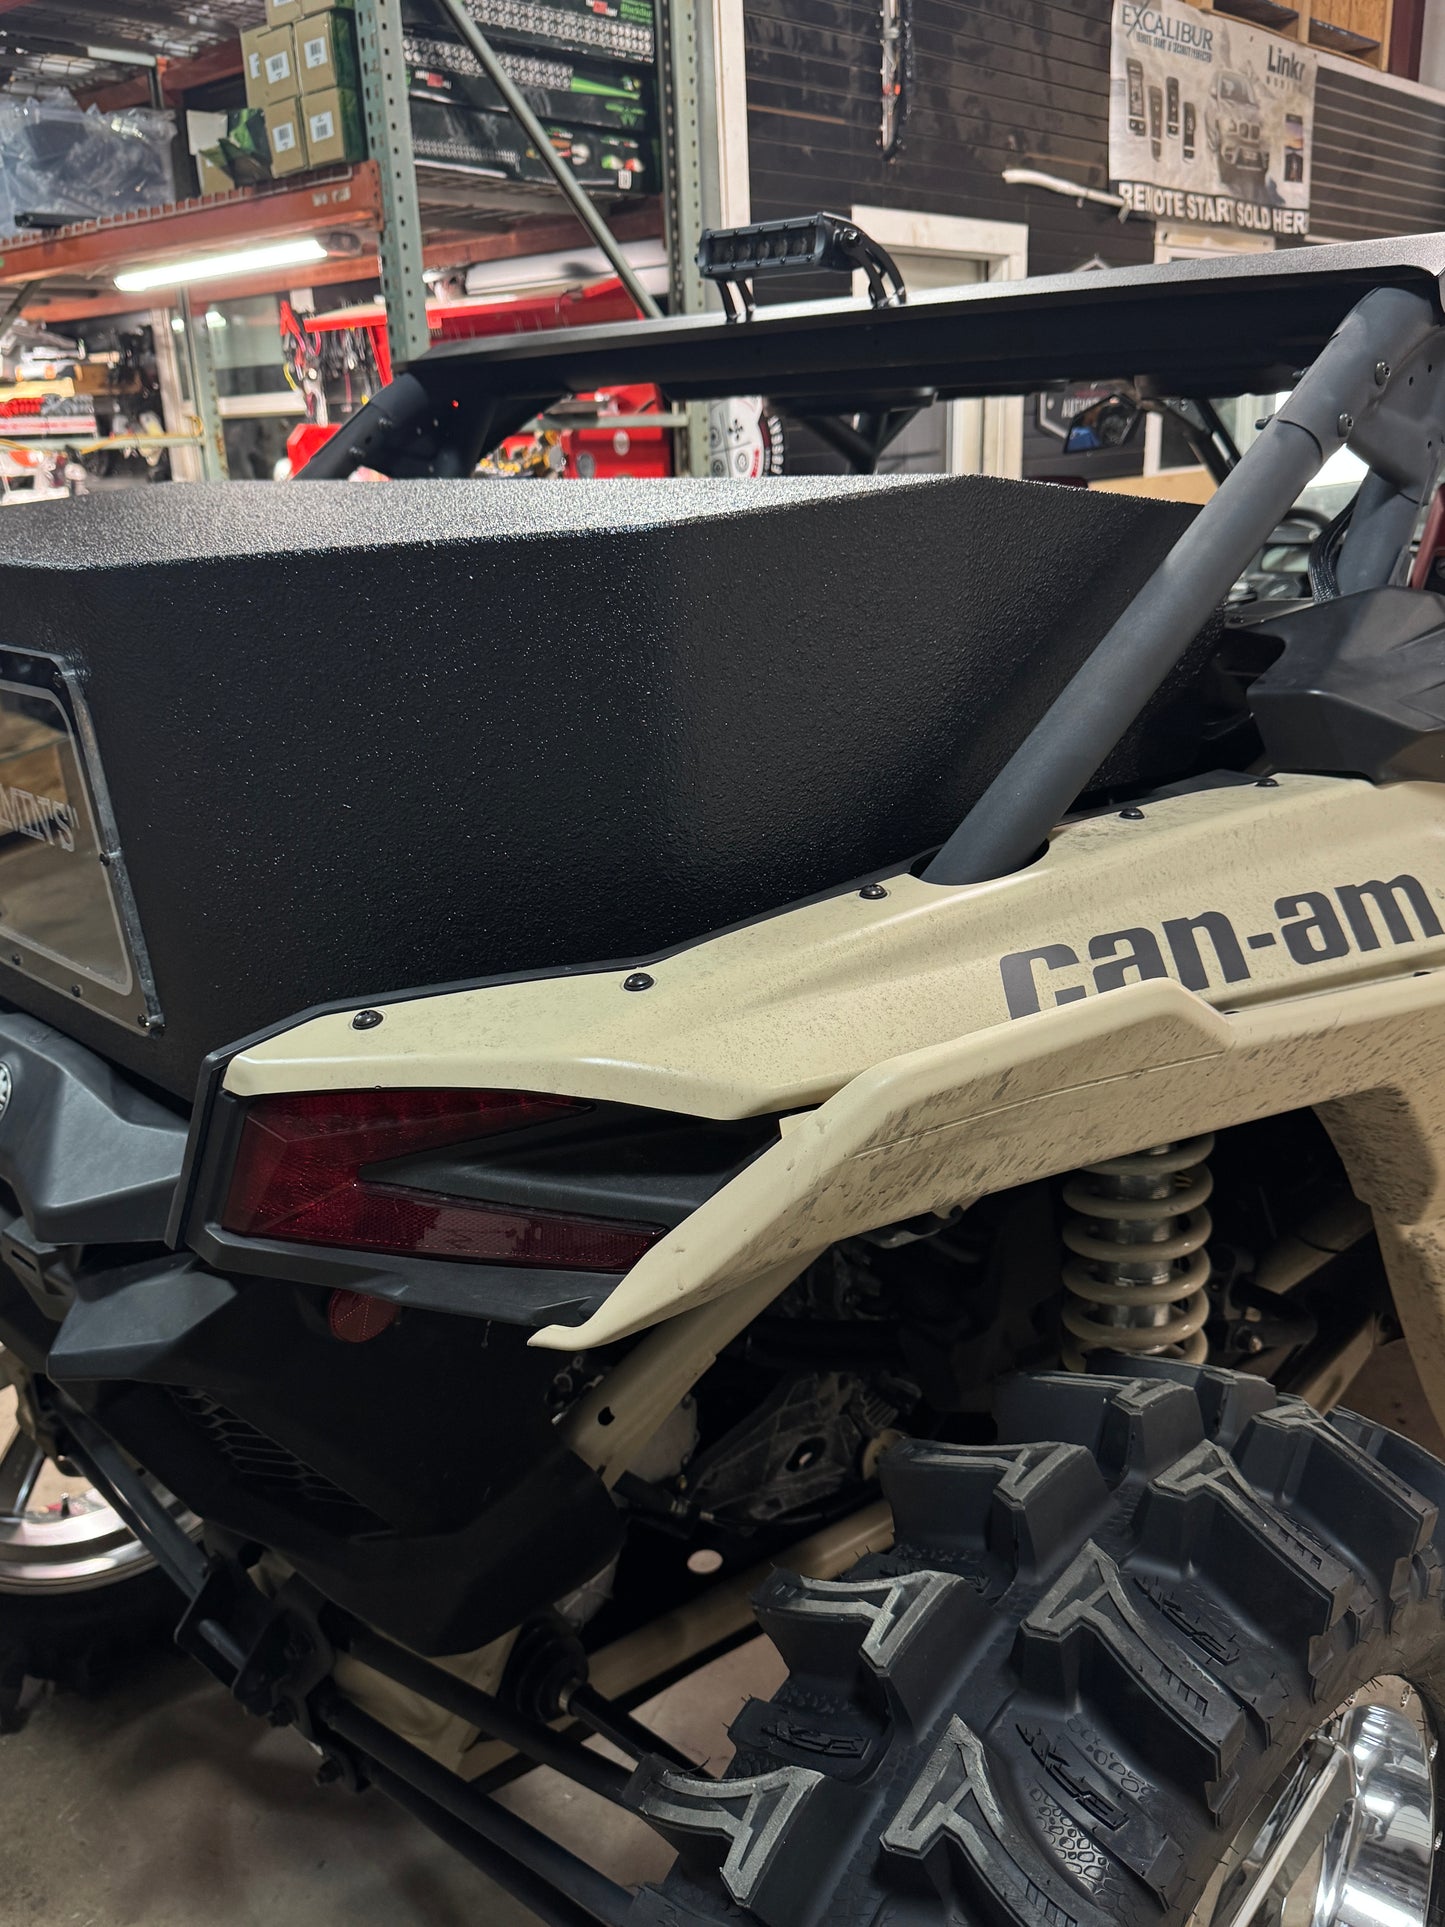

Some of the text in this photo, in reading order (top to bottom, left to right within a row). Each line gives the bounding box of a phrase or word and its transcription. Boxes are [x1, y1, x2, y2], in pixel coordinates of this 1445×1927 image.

[1121, 0, 1214, 50] EXCALIBUR
[1187, 192, 1236, 223] START
[1237, 202, 1271, 231] SOLD
[1273, 208, 1310, 235] HER
